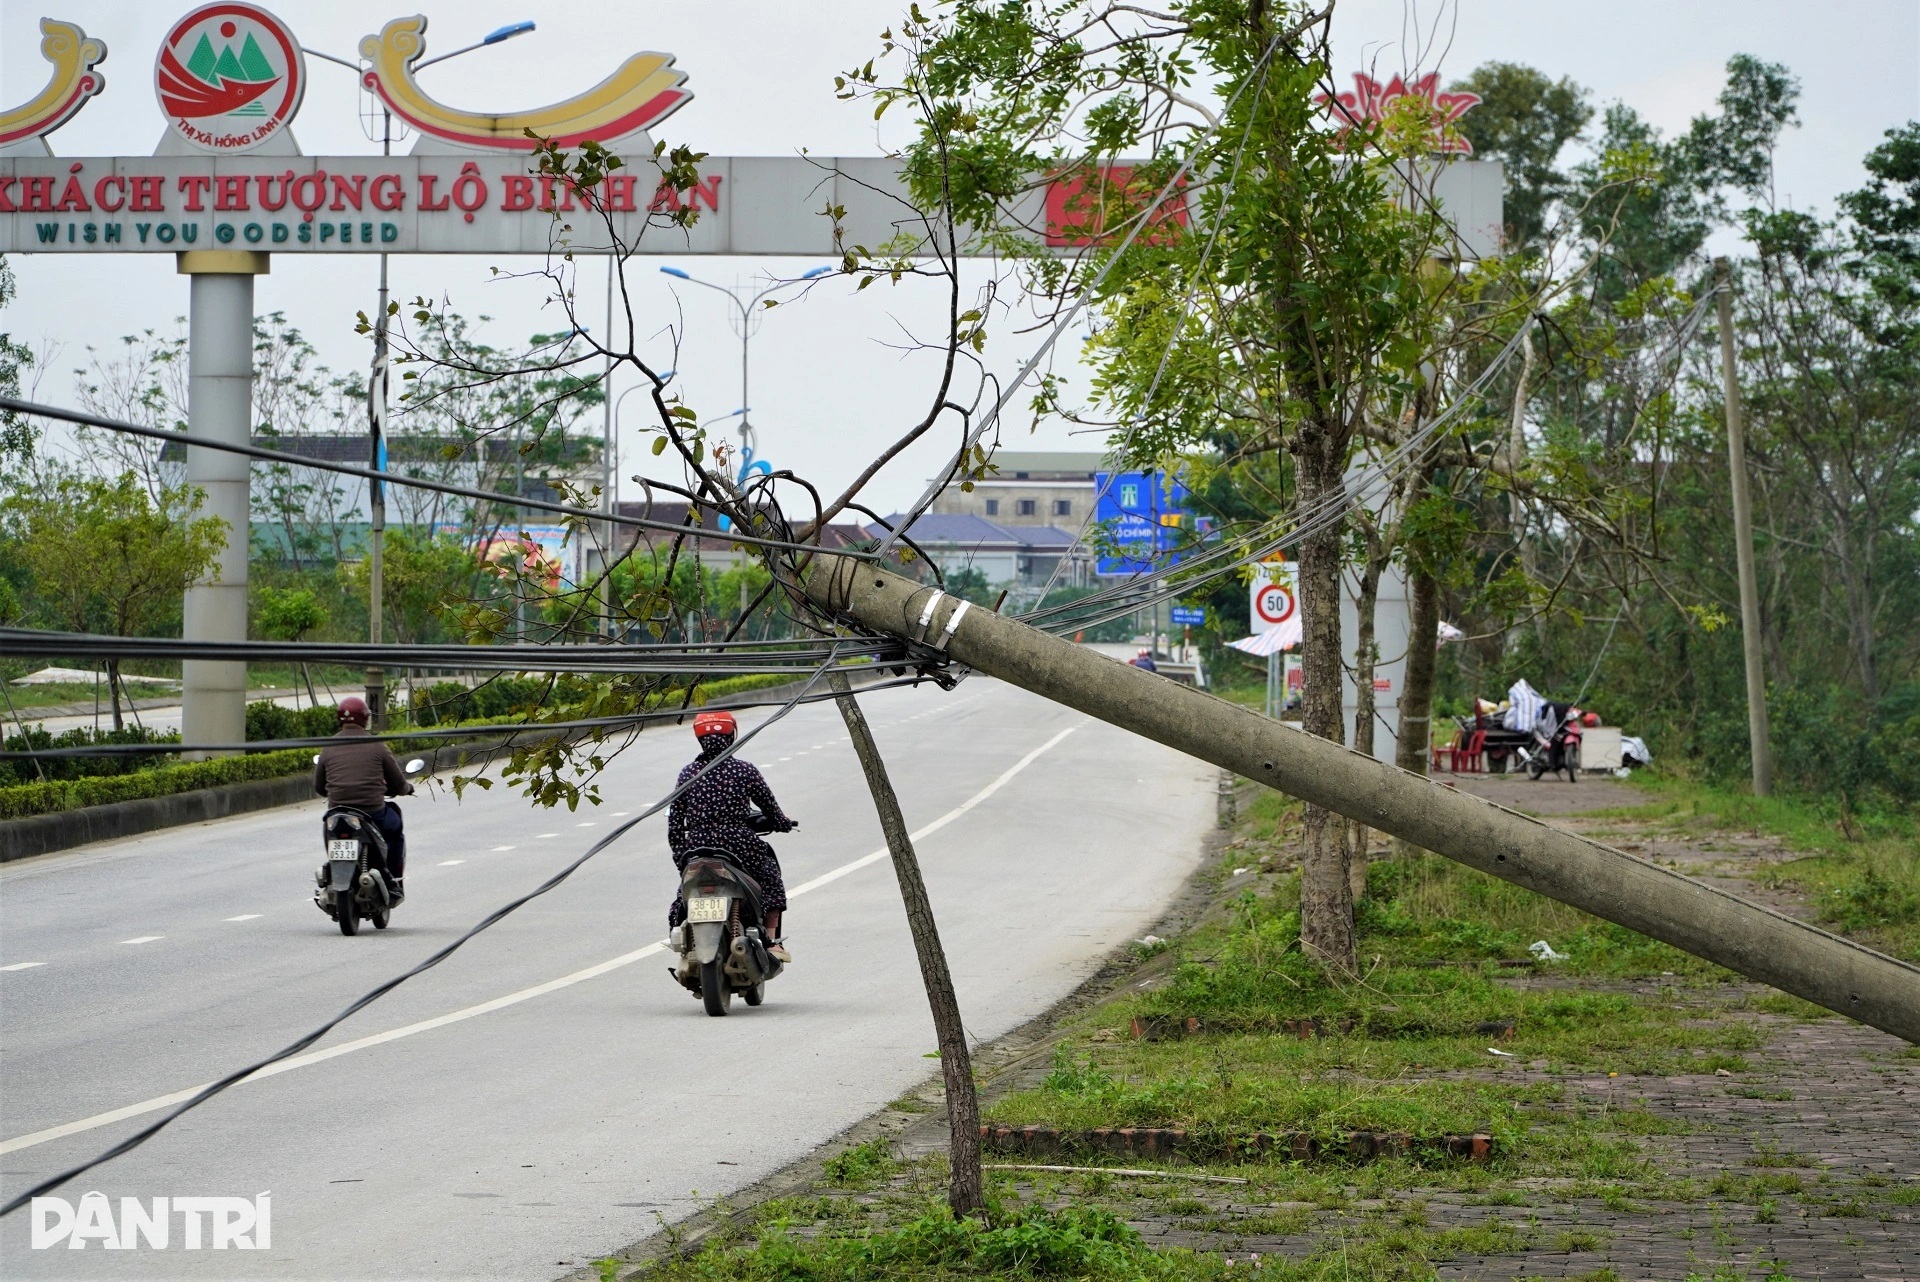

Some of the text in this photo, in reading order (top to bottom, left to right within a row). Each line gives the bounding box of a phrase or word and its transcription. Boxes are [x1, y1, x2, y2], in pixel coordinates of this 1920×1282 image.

[178, 117, 279, 147] THỊ XÃ HỒNG LĨNH
[178, 169, 406, 223] THƯỢNG
[418, 161, 488, 223] LỘ
[36, 222, 397, 243] WISH YOU GODSPEED
[1268, 596, 1283, 611] 50
